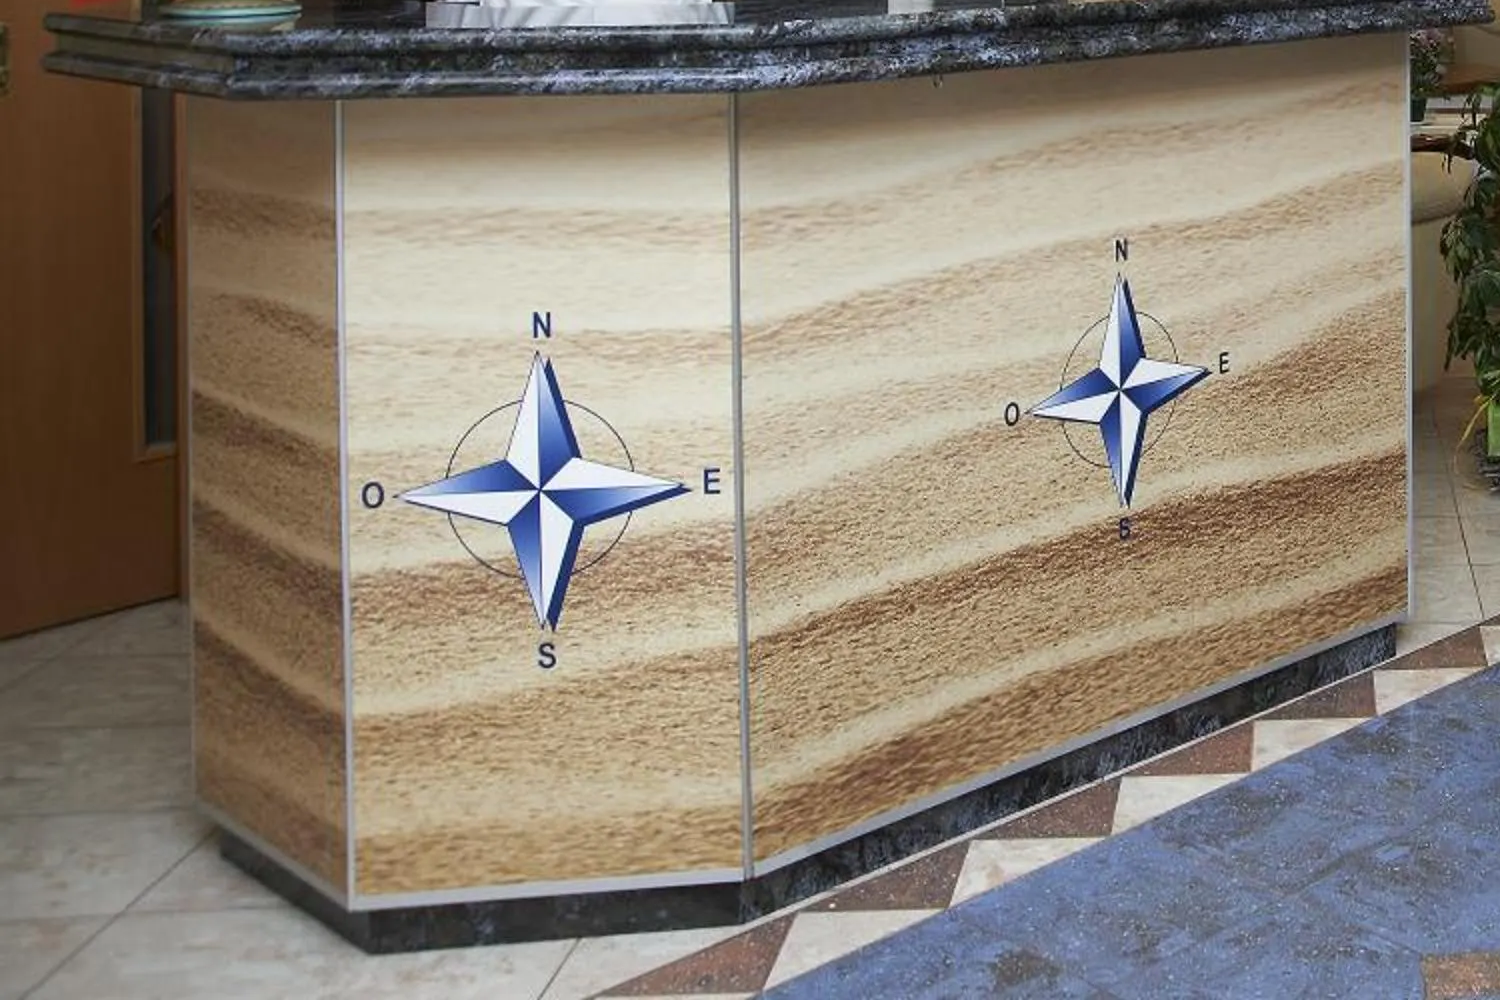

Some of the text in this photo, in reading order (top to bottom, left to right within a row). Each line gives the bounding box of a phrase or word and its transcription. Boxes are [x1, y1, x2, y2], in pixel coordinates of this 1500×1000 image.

[1115, 239, 1129, 262] N
[533, 311, 551, 339] N
[1219, 351, 1230, 374] E
[1004, 401, 1021, 426] O
[361, 481, 385, 509] O
[704, 468, 721, 495] E
[538, 642, 557, 669] S
